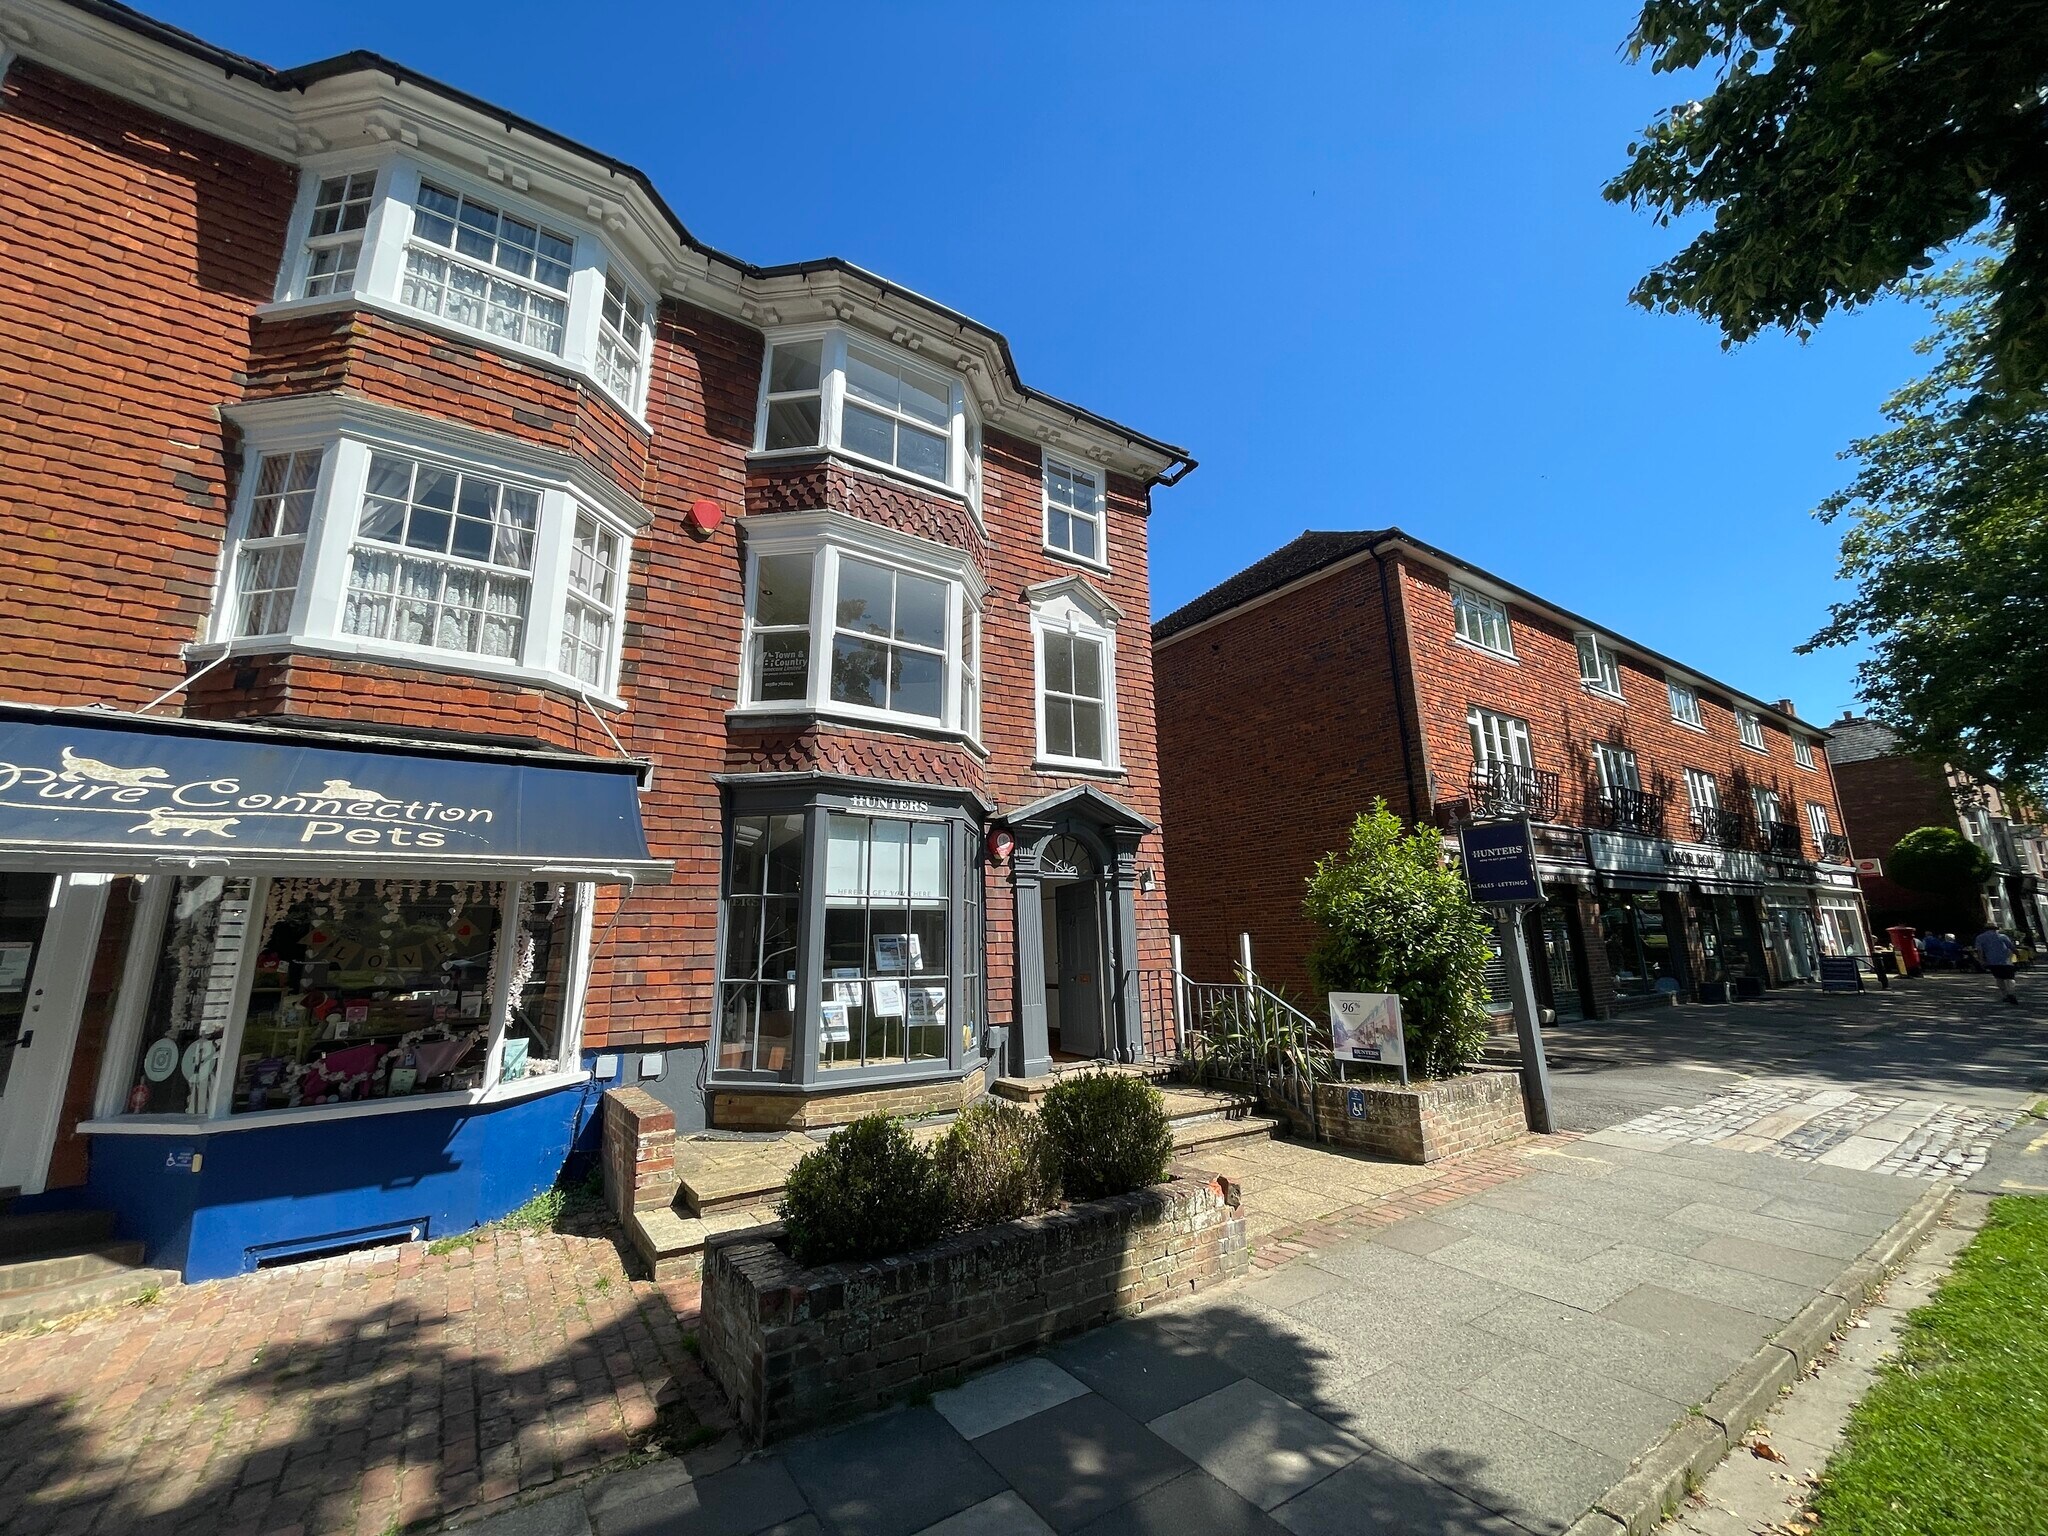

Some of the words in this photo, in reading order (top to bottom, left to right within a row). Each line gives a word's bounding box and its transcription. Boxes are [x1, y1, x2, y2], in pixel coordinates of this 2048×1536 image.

[774, 651, 796, 659] Town
[797, 650, 804, 658] &
[774, 658, 808, 667] Country
[0, 762, 150, 802] Pure
[171, 778, 494, 823] Connection
[849, 794, 929, 813] HUNTERS
[300, 820, 446, 848] Pets
[1471, 845, 1523, 858] HUNTERS
[1497, 880, 1529, 888] LETTINGS
